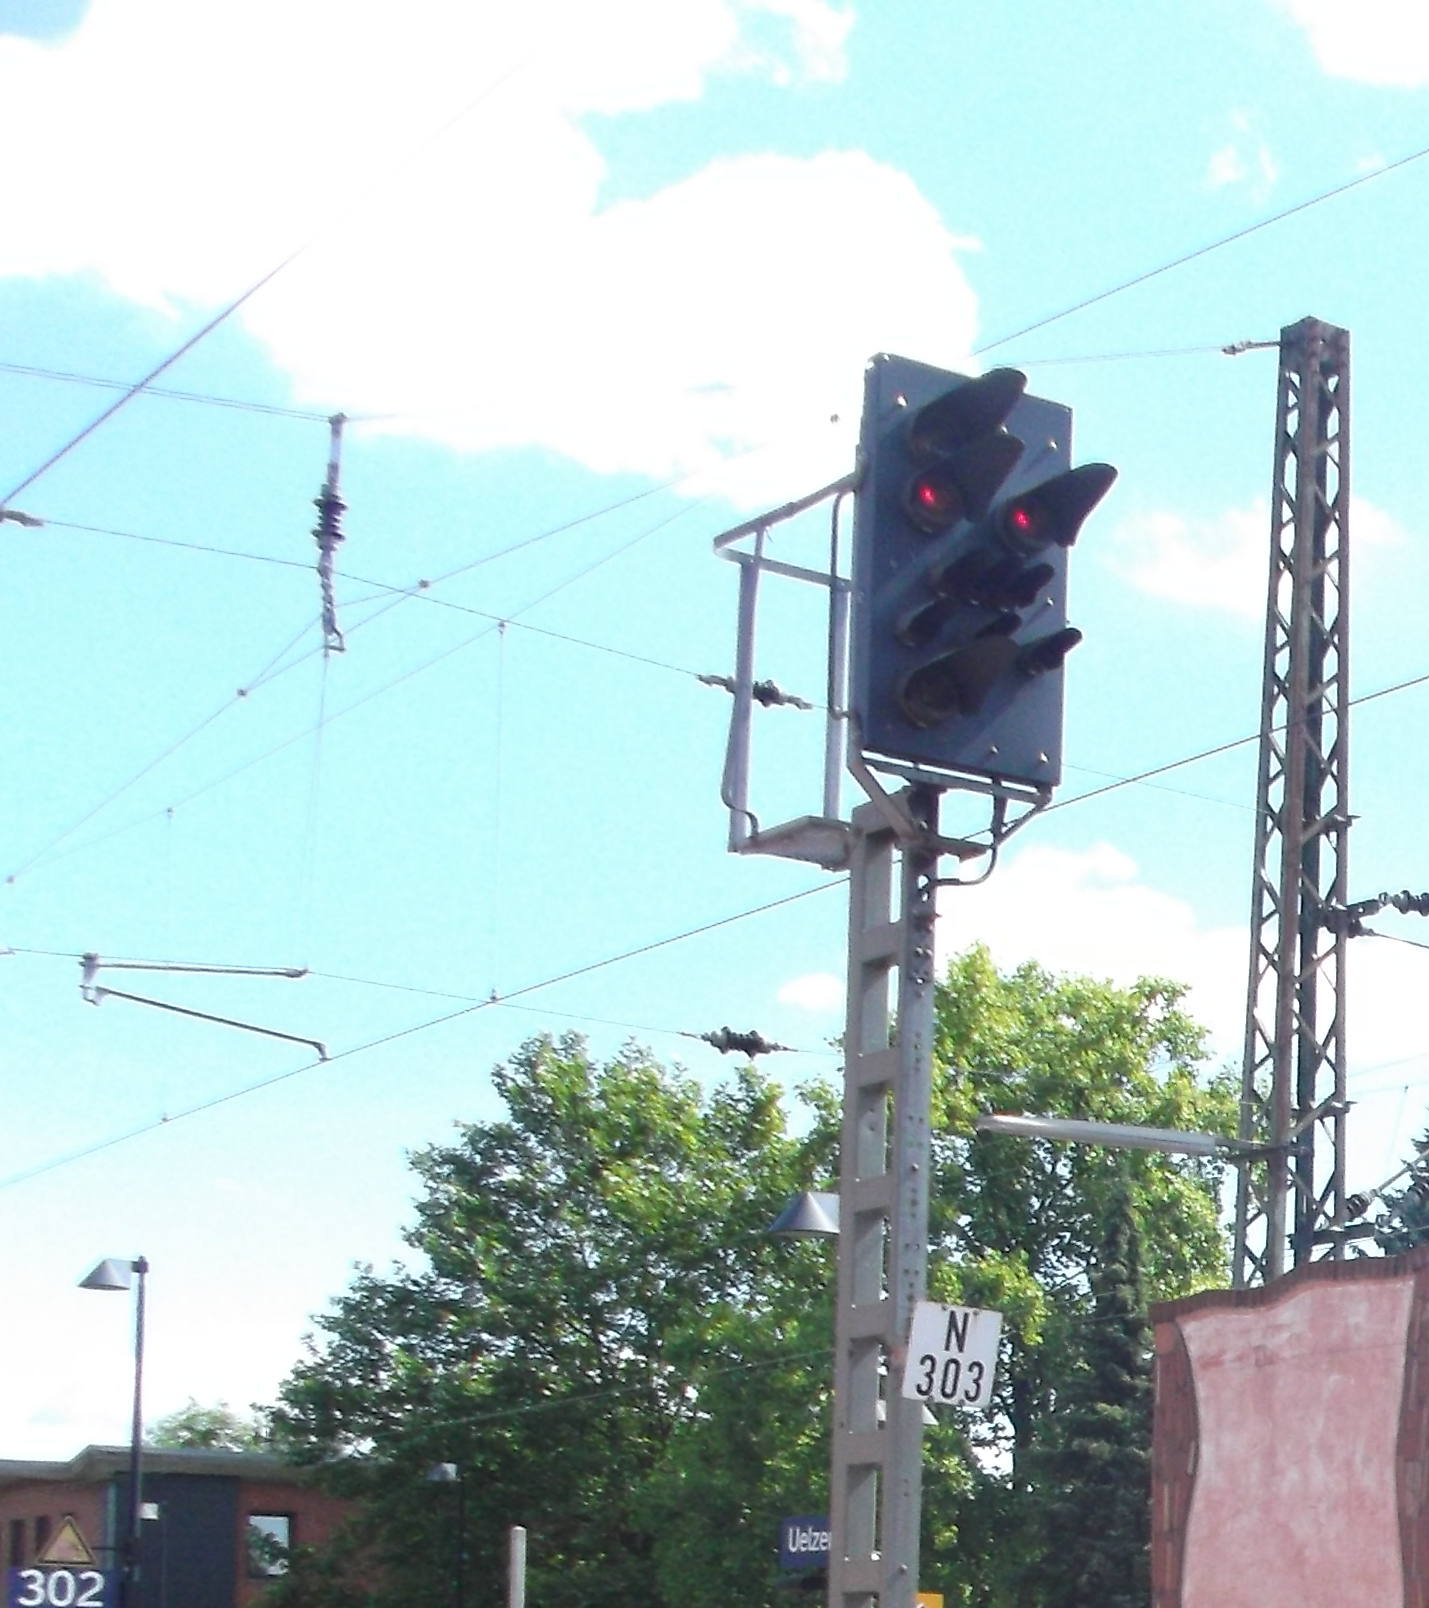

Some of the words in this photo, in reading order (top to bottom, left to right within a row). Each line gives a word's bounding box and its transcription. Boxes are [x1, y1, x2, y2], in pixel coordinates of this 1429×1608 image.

[944, 1310, 970, 1353] N
[916, 1354, 985, 1402] 303
[17, 1568, 105, 1608] 302
